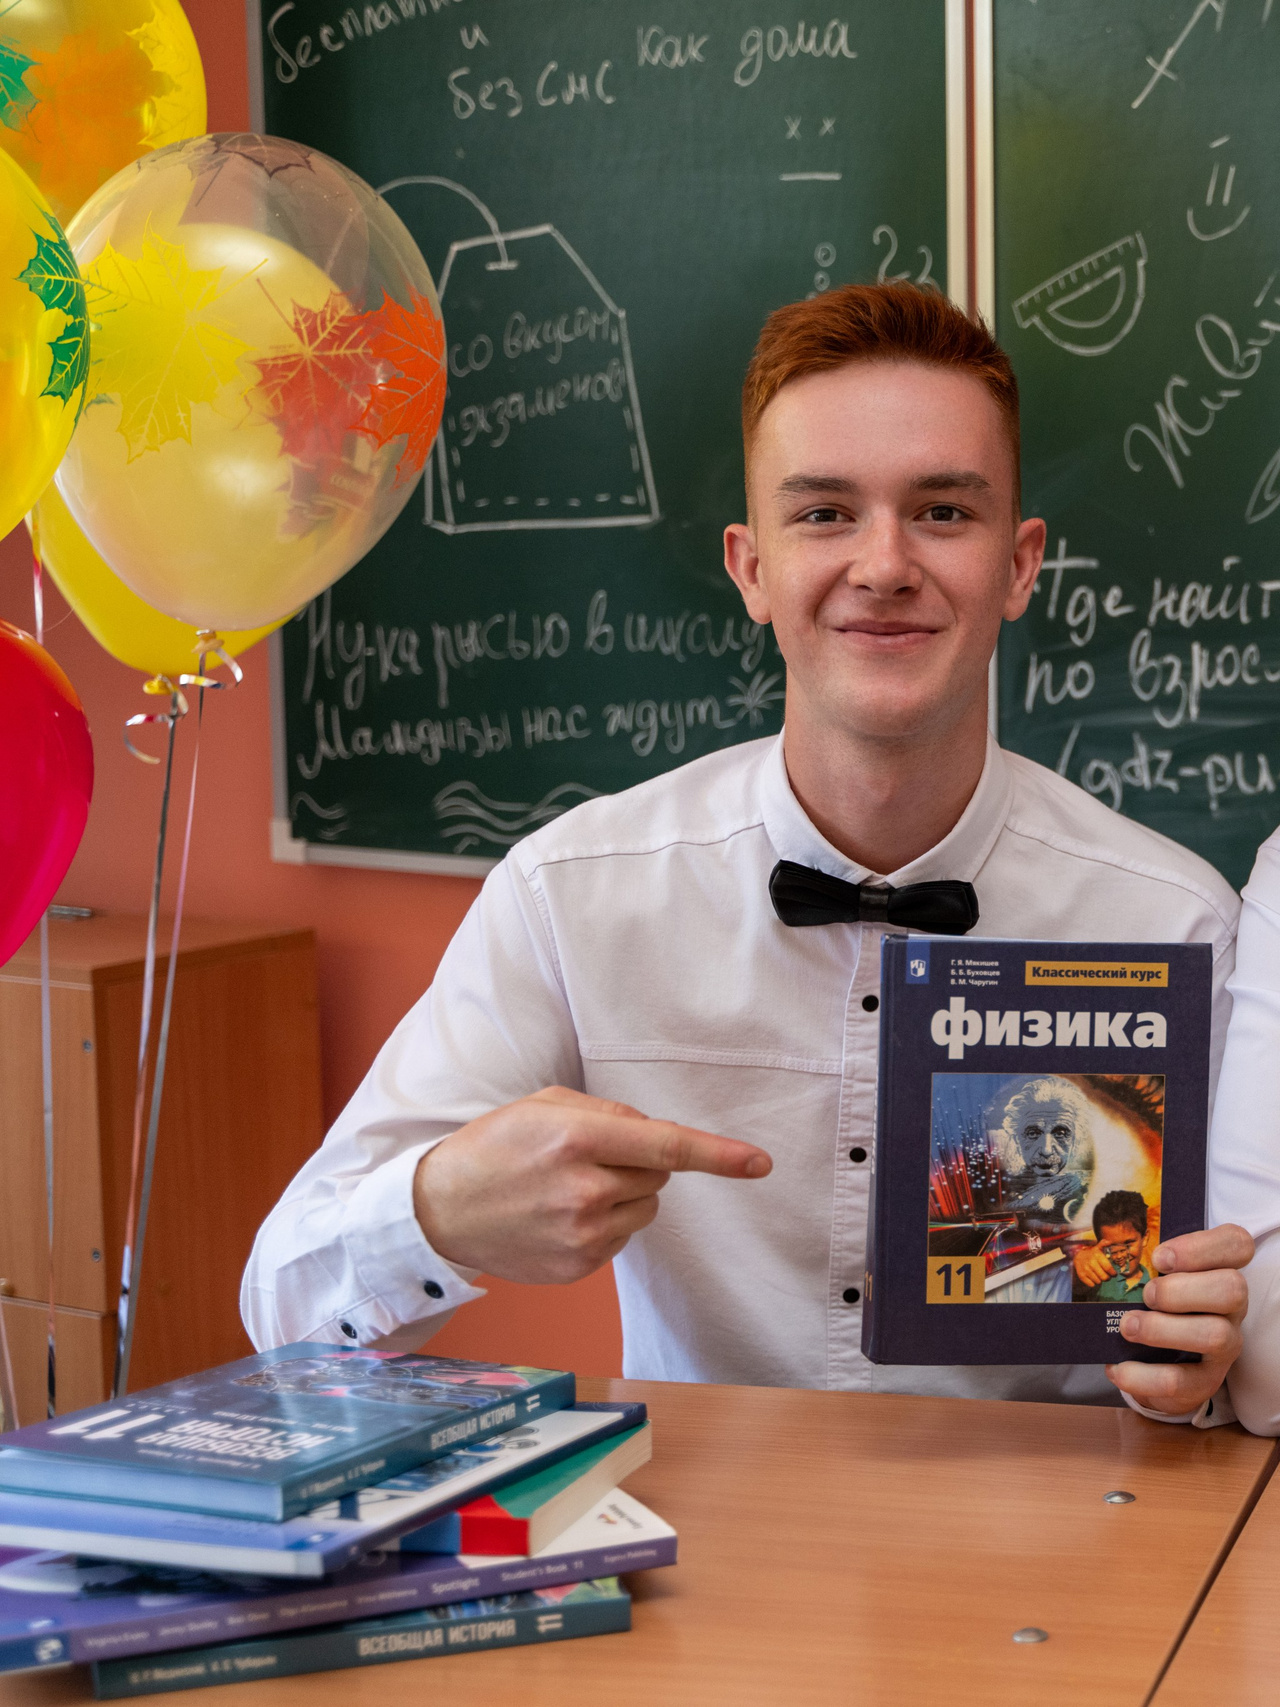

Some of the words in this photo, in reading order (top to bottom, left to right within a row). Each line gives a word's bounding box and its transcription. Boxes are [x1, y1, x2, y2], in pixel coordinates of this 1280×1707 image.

[460, 24, 489, 50] и
[734, 18, 858, 87] дома
[448, 66, 523, 119] без
[1025, 652, 1096, 714] по
[521, 704, 591, 749] нас
[602, 694, 738, 758] ждут
[969, 979, 998, 987] Чаругин
[1032, 966, 1126, 979] Классический
[1130, 969, 1162, 981] курс
[930, 997, 1168, 1059] физика
[936, 1263, 971, 1296] 11
[47, 1409, 167, 1440] 11
[431, 1578, 480, 1595] Spotlight
[358, 1628, 444, 1657] ВСЕОБЩАЯ
[449, 1619, 517, 1644] ИСТОРИЯ
